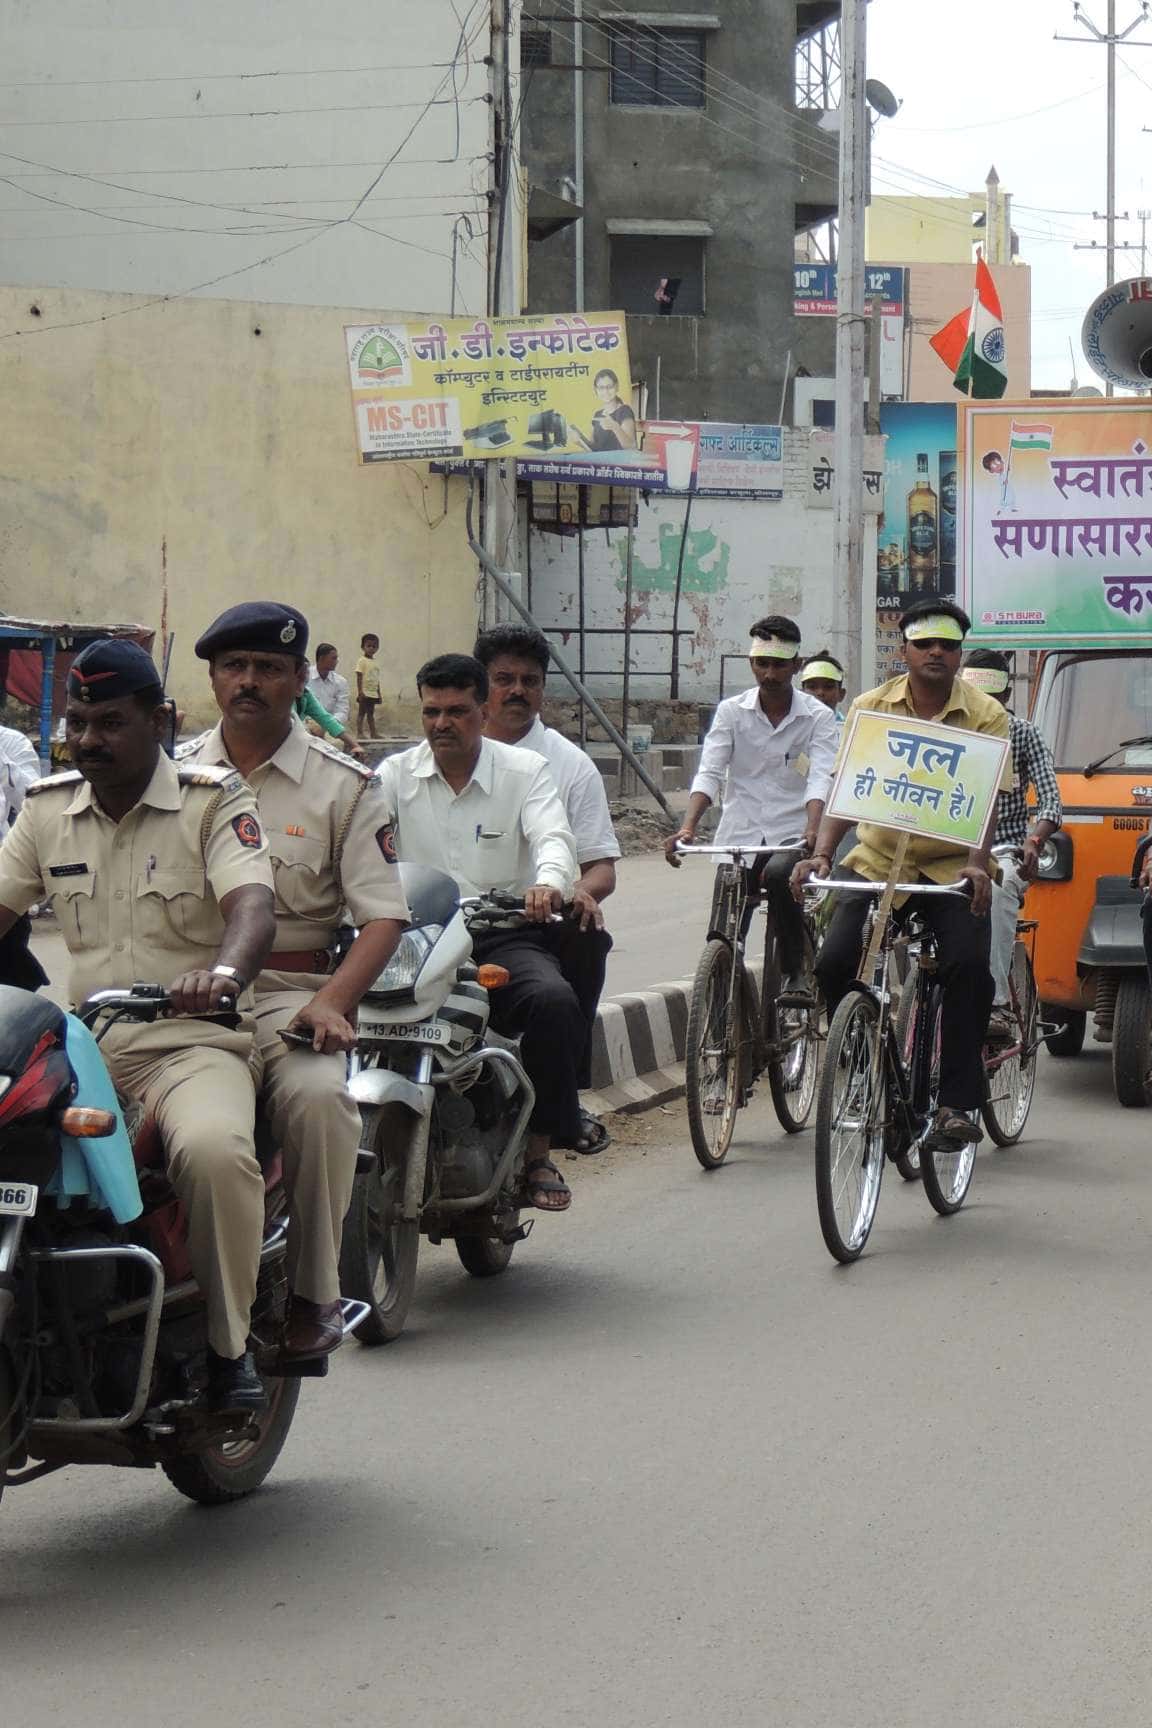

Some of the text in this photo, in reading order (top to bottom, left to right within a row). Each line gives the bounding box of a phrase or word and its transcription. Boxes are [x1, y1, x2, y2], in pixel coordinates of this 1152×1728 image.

[366, 402, 449, 432] MS-CIT
[877, 596, 901, 608] GAR
[887, 730, 966, 778] जल
[853, 767, 877, 800] ही
[882, 773, 944, 811] जीवन
[1113, 818, 1145, 831] GOODS
[0, 1187, 26, 1205] 66
